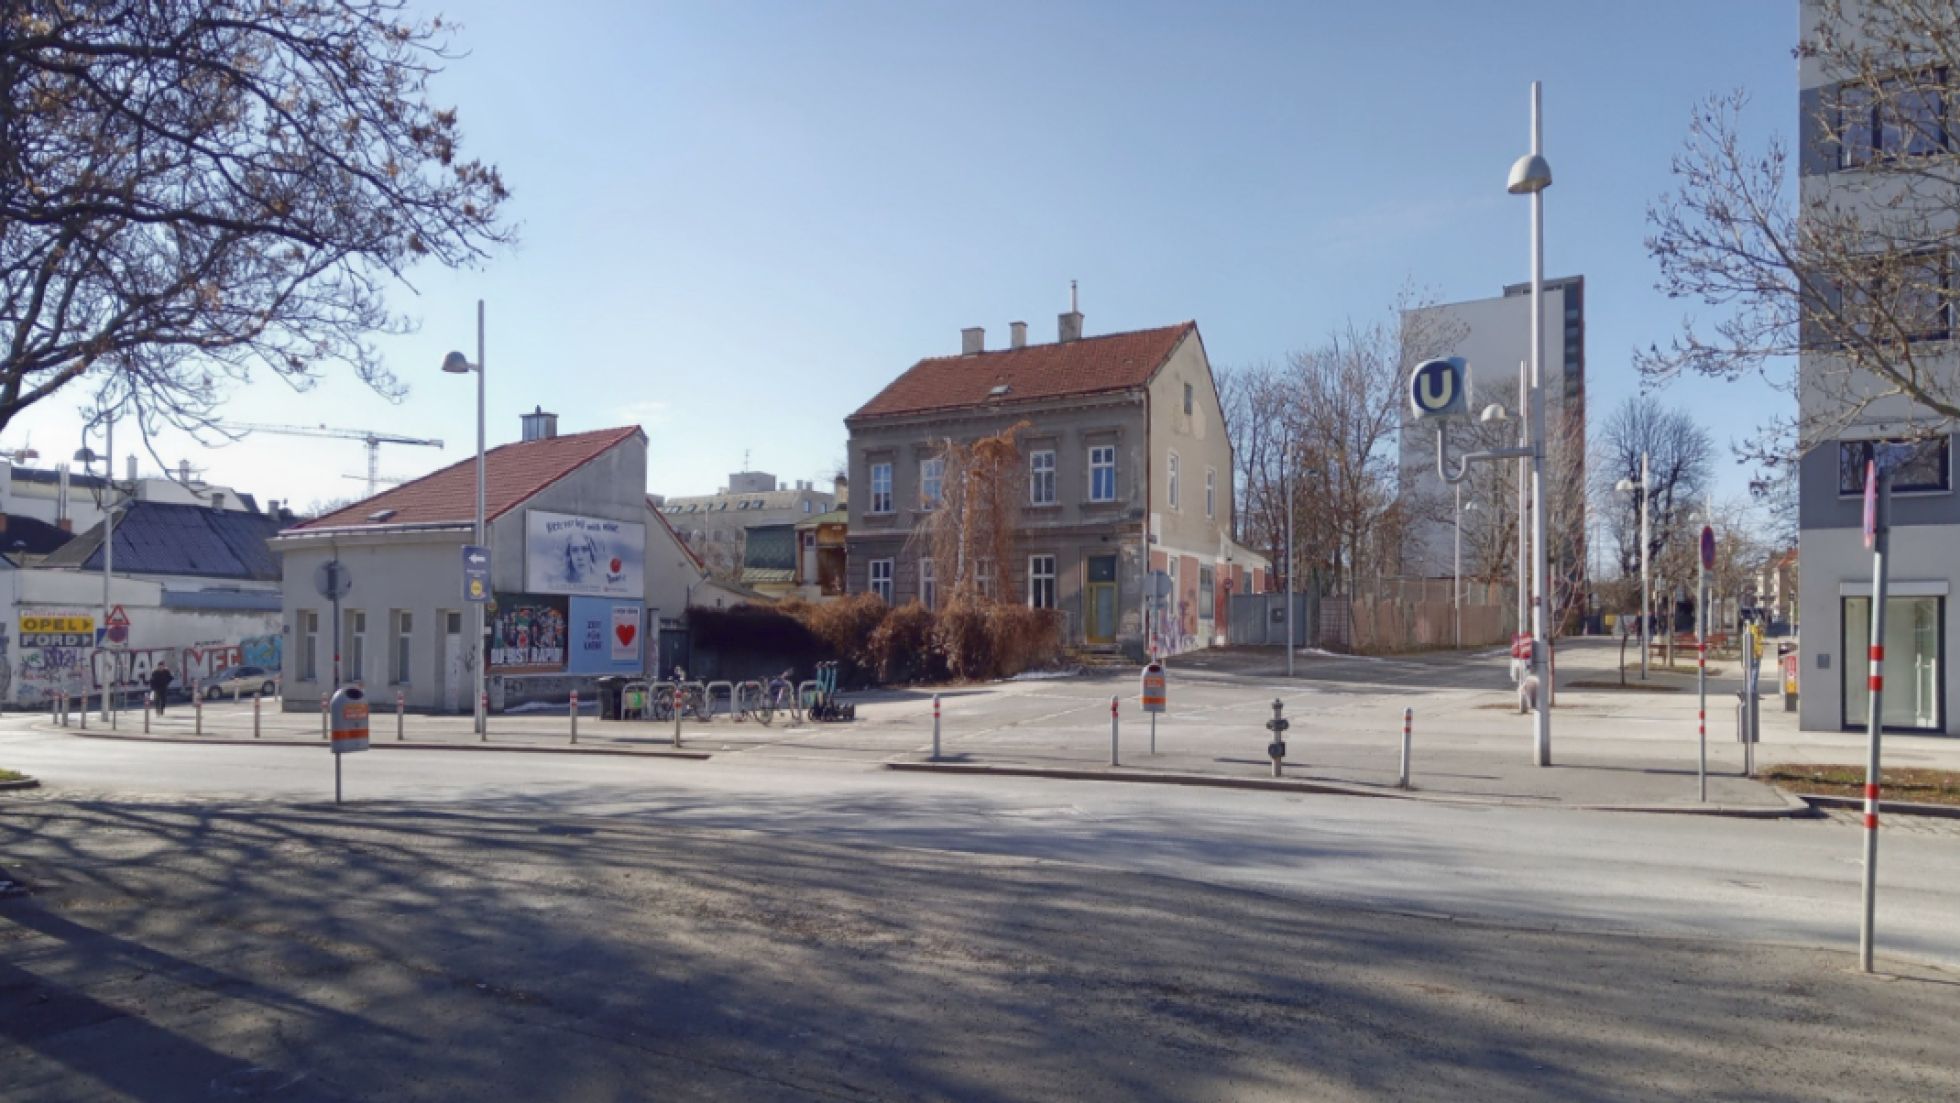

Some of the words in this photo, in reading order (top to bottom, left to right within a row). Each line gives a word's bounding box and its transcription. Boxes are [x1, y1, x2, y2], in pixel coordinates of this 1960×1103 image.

[1420, 369, 1453, 409] U
[23, 617, 76, 631] OPEL
[22, 633, 78, 646] FORD
